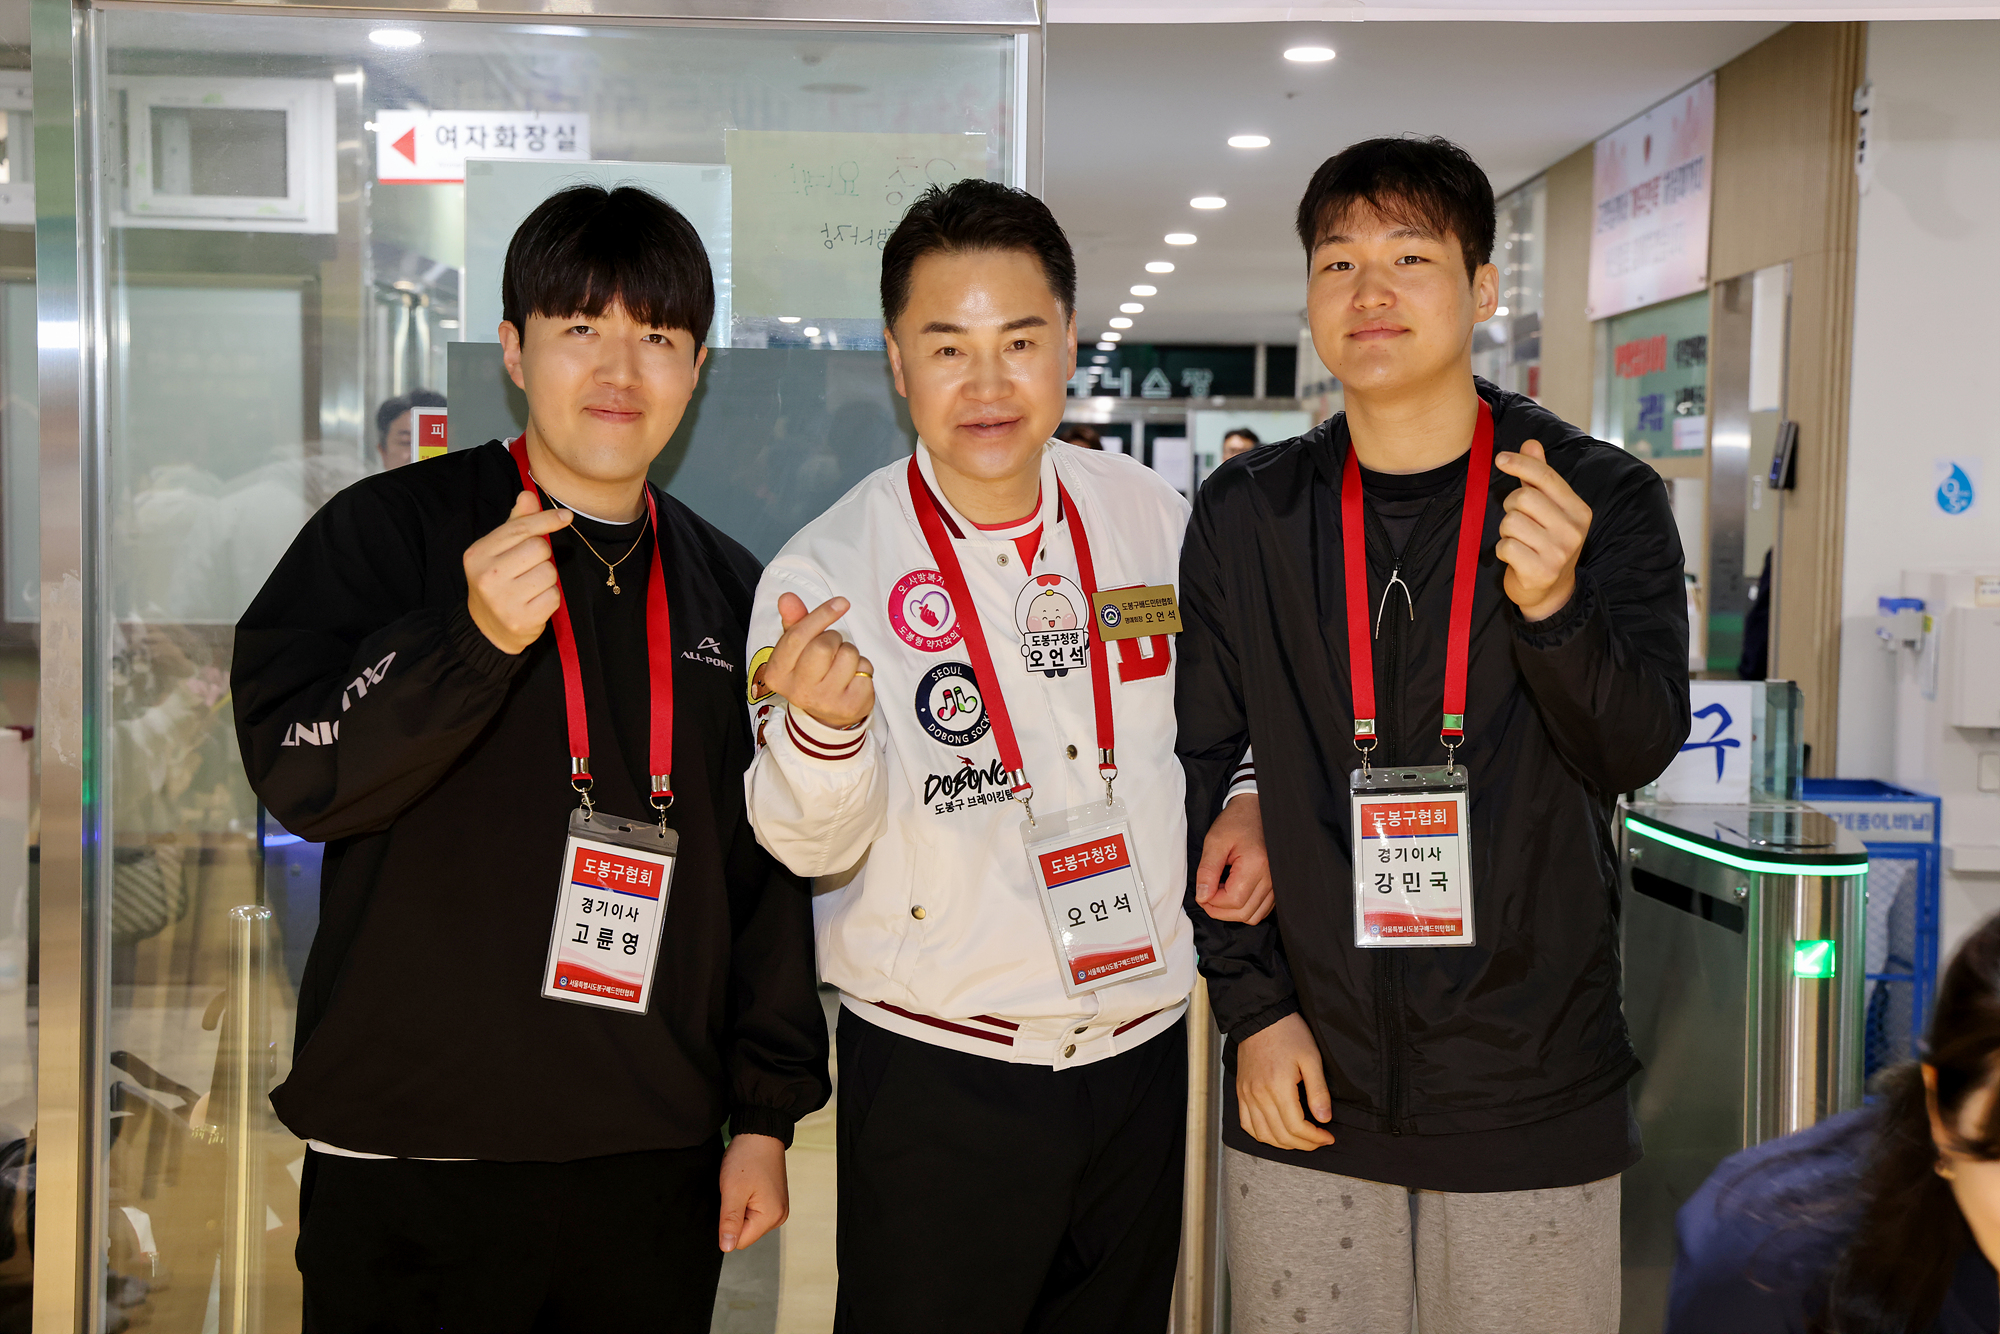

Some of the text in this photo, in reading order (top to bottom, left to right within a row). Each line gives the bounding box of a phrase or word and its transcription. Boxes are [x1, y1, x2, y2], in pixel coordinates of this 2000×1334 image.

[436, 125, 576, 152] 여자화장실
[1031, 631, 1080, 647] 도봉구청장
[931, 665, 963, 682] SEOUL
[927, 723, 970, 744] DOBONG
[923, 758, 1008, 806] DOBONG
[934, 799, 965, 816] 도봉구
[1372, 808, 1447, 828] 도봉구협회
[1051, 843, 1118, 875] 도봉구청장
[1377, 846, 1442, 863] 경기이사
[582, 857, 653, 888] 도봉구협회
[581, 897, 640, 923] 경기이사
